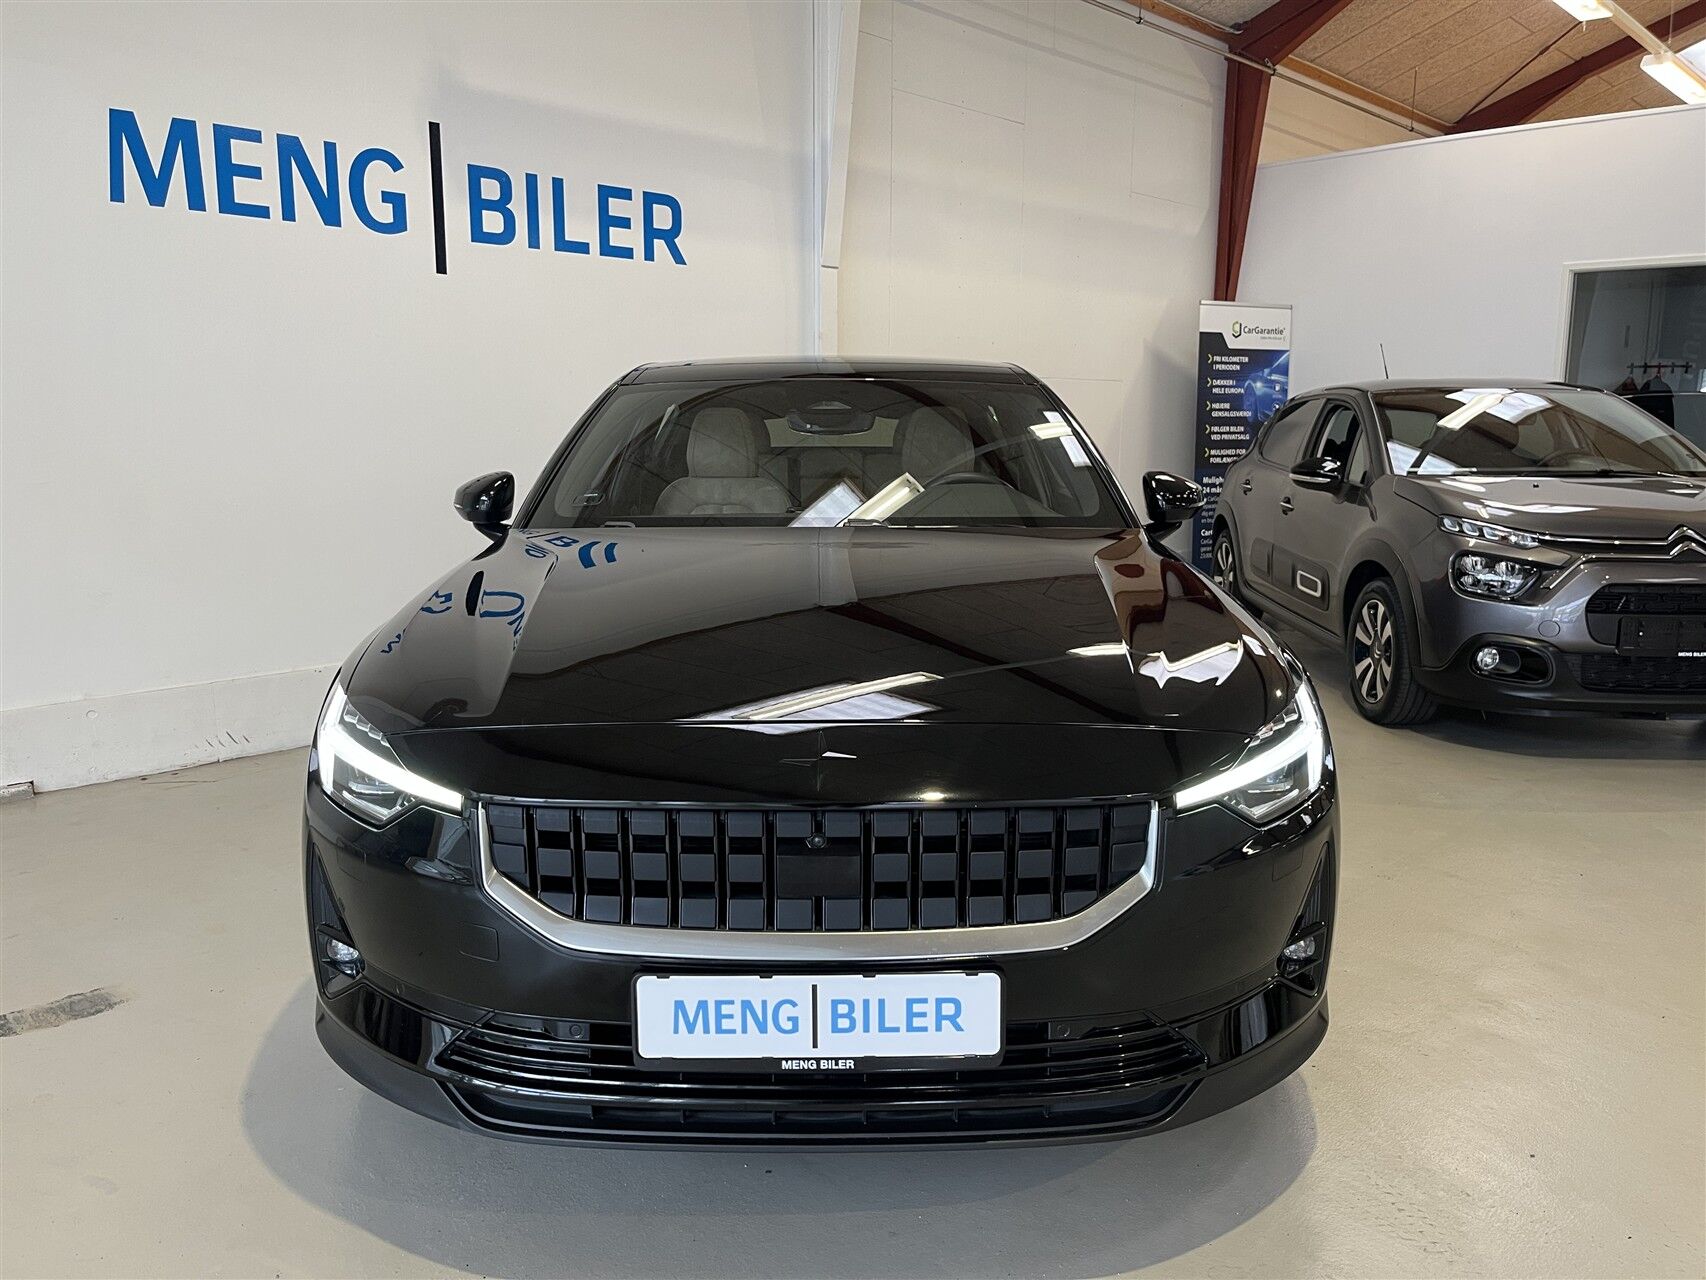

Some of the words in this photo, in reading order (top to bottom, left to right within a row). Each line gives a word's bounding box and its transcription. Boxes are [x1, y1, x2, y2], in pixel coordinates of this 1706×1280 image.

[108, 107, 408, 235] MENG
[467, 163, 687, 266] BILER
[1243, 325, 1284, 335] CarGarantie
[672, 999, 800, 1035] MENG
[830, 997, 965, 1034] BILER
[781, 1059, 818, 1070] MENG
[820, 1059, 855, 1070] BILER
